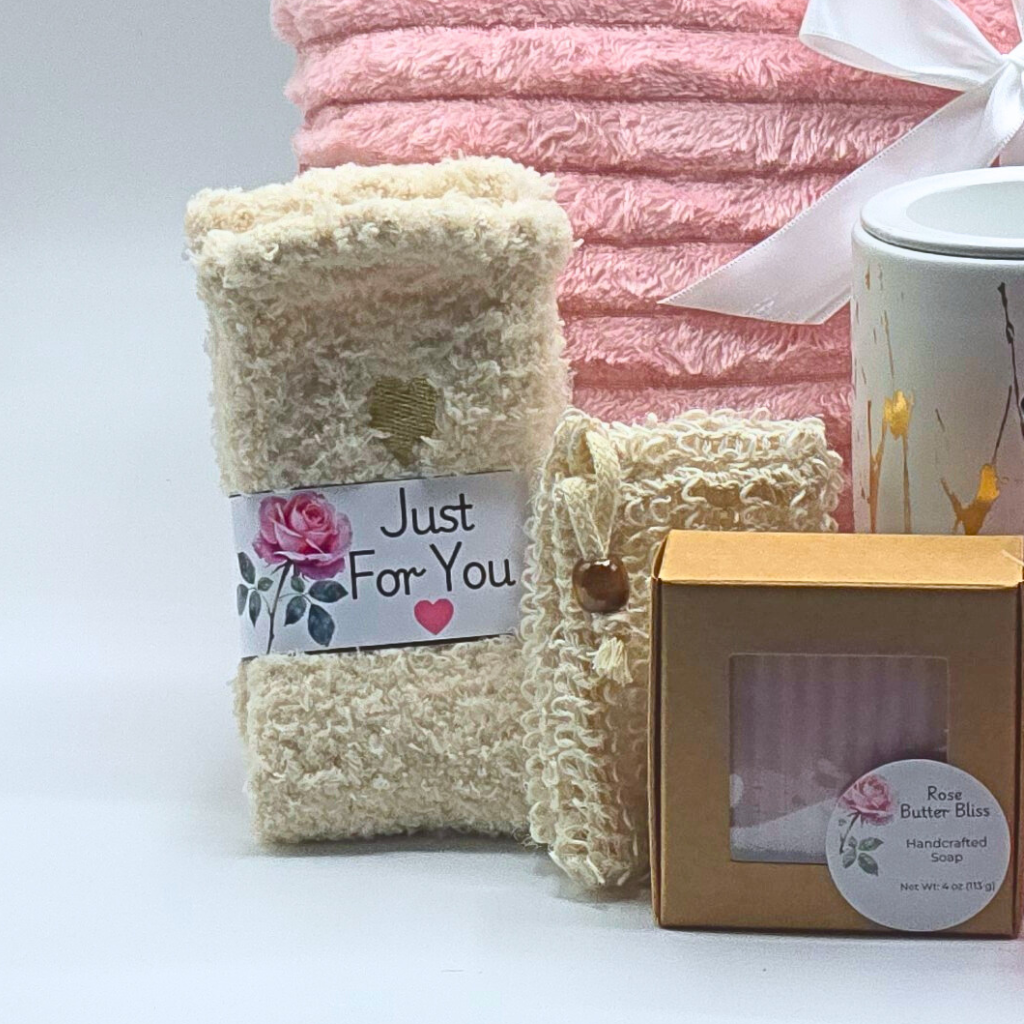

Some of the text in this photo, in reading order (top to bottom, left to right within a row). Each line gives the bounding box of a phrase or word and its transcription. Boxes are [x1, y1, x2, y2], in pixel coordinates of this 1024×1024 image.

[380, 487, 475, 538] Just
[349, 541, 516, 600] For You
[927, 785, 963, 801] Rose
[900, 803, 990, 819] Butter Bliss
[906, 836, 987, 849] Handcrafted
[931, 852, 963, 864] Soap
[900, 882, 919, 891] Net
[942, 882, 949, 890] 4
[952, 883, 964, 891] oz
